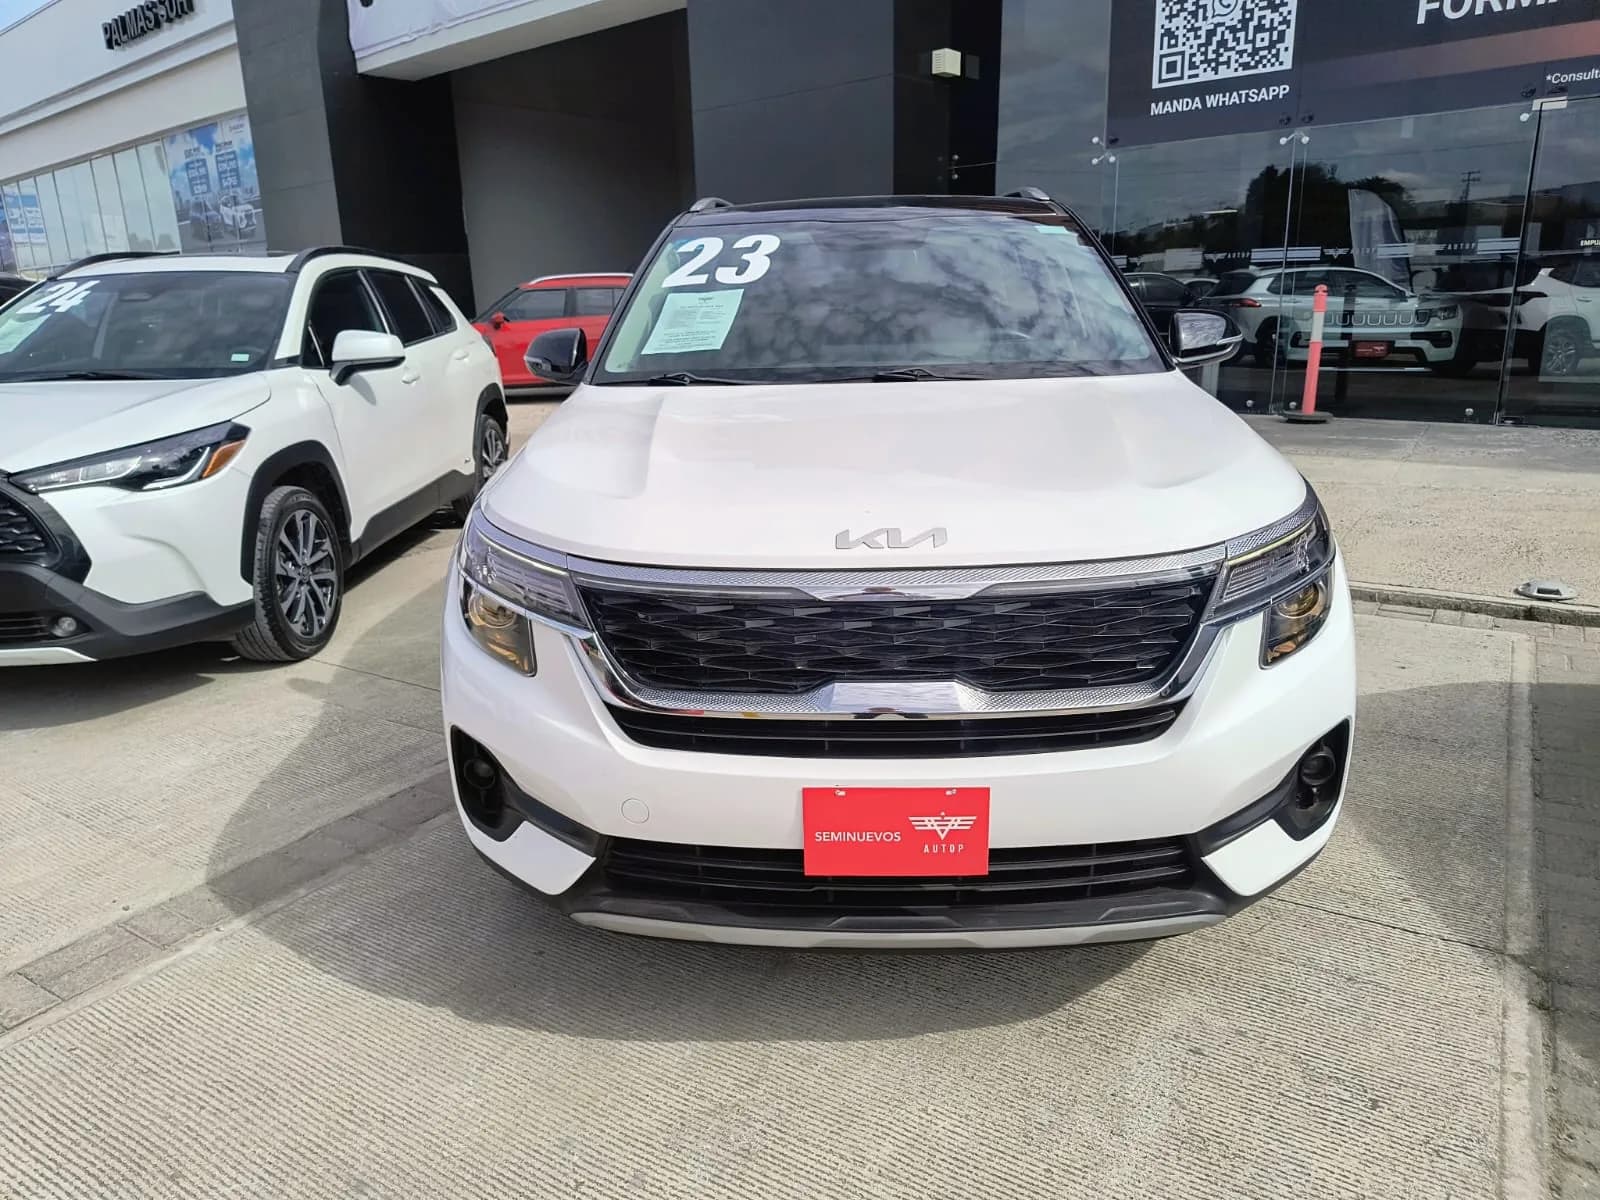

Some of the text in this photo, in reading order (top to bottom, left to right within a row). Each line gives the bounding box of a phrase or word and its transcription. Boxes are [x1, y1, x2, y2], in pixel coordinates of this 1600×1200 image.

[102, 1, 157, 49] PALMAS
[1416, 0, 1557, 25] FOR
[1545, 67, 1600, 84] Consult
[1150, 84, 1290, 116] MANDA WHATSAPP
[661, 234, 781, 288] 23
[16, 280, 101, 314] 24
[835, 527, 948, 550] KIA
[815, 831, 901, 842] SEMINUEVOS
[923, 844, 965, 853] AUTOP
